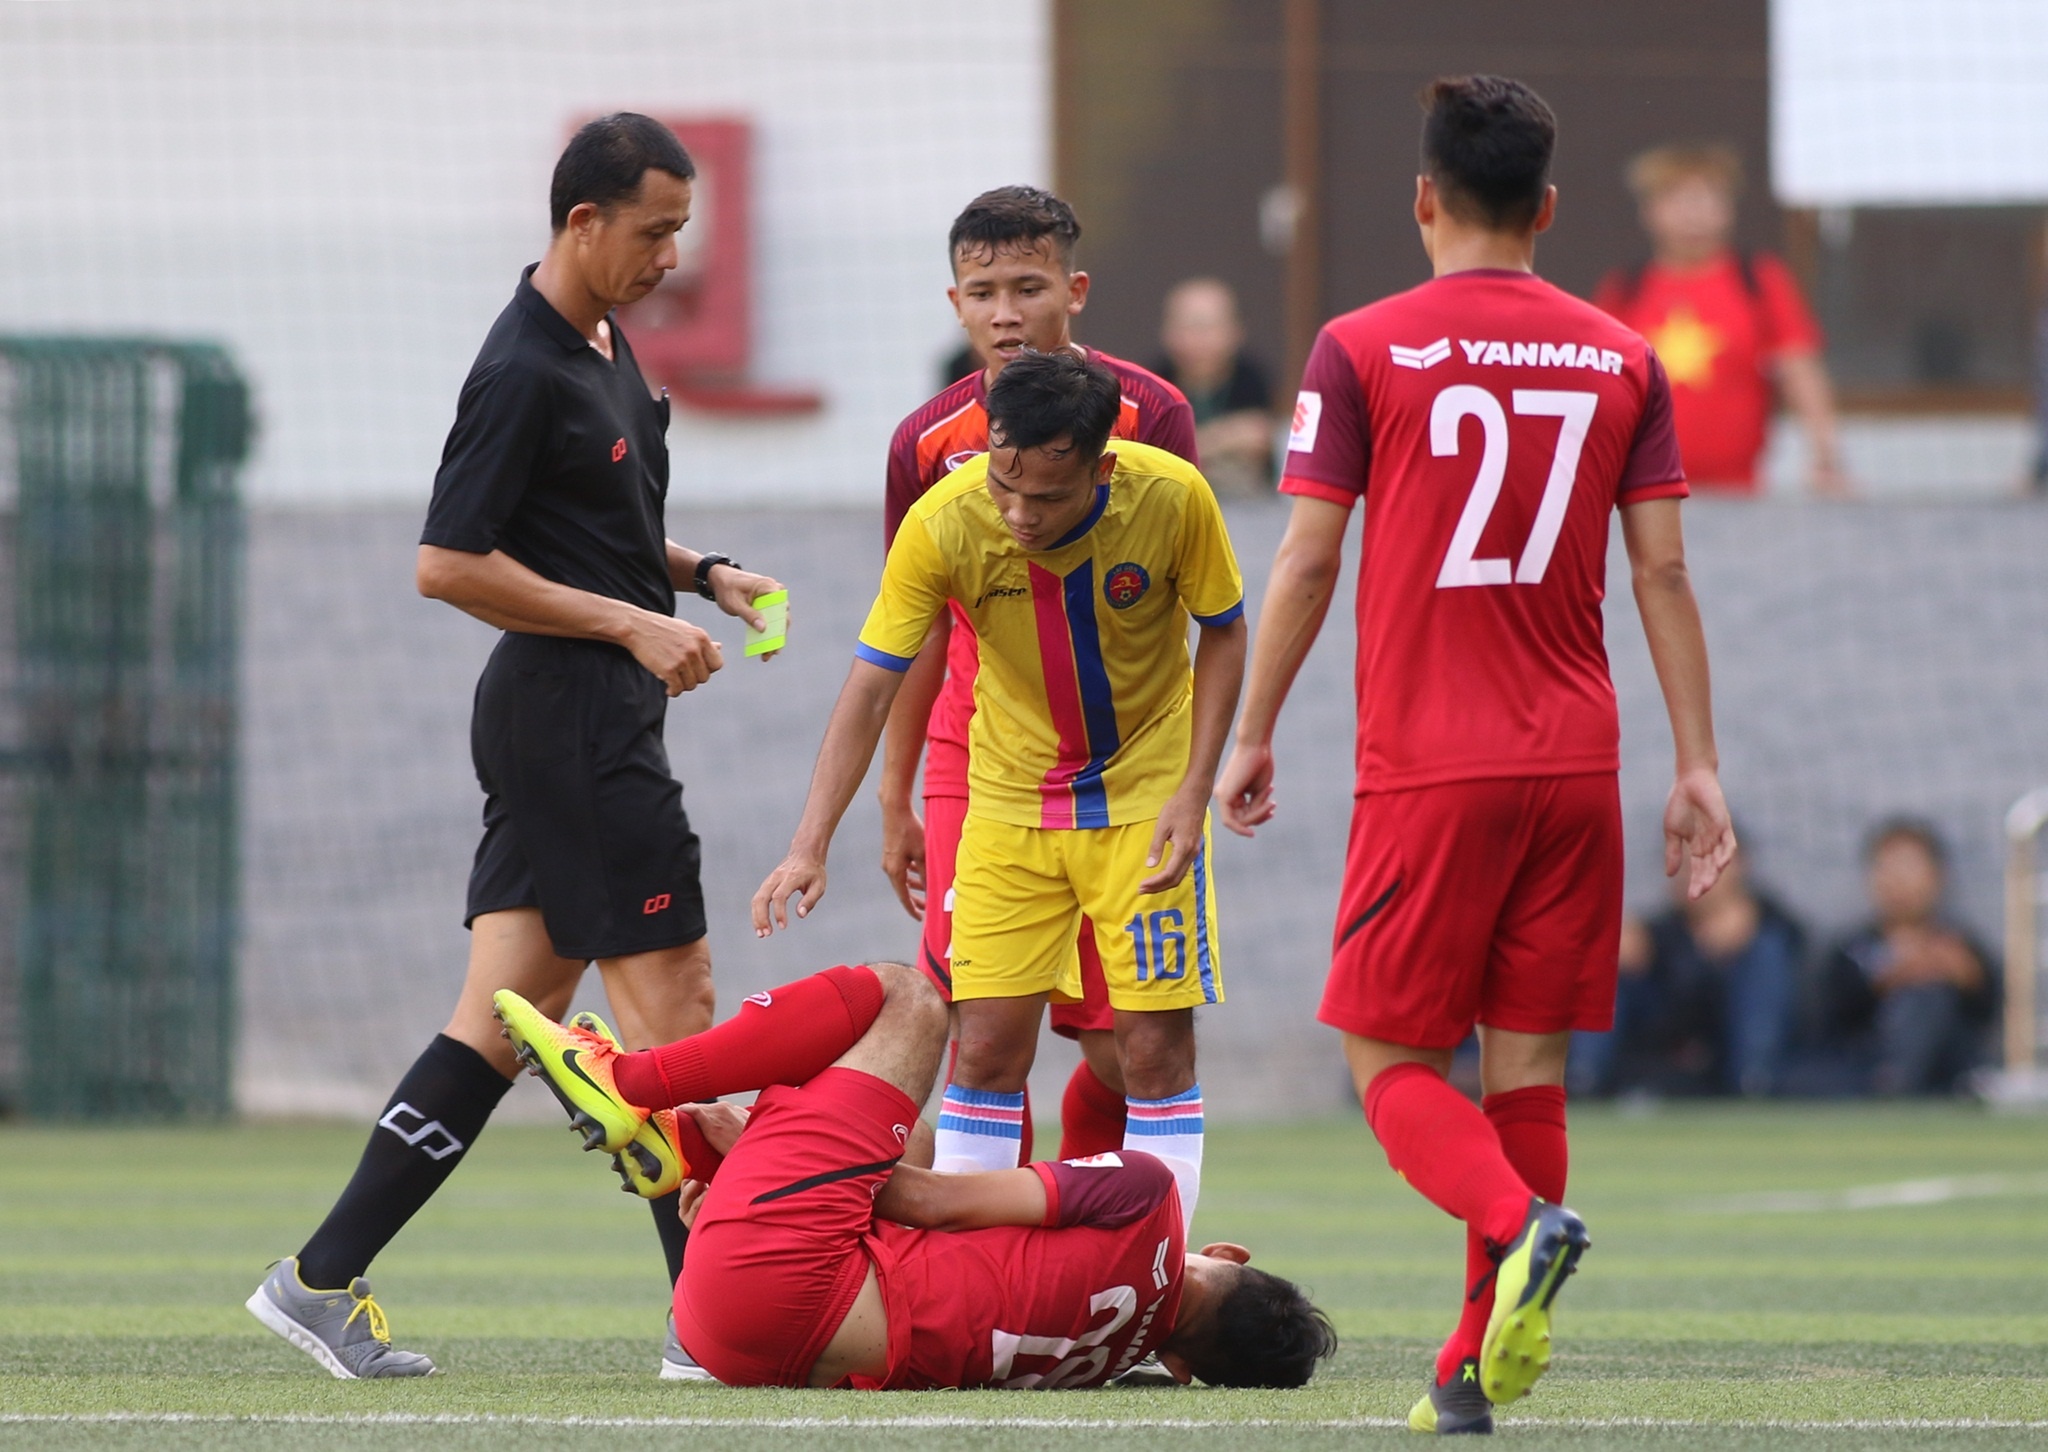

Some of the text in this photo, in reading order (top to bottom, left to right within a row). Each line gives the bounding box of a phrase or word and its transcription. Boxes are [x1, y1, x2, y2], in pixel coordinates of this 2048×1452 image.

[1458, 338, 1624, 376] YANMAR
[1429, 384, 1599, 589] 27
[1125, 907, 1186, 982] 16
